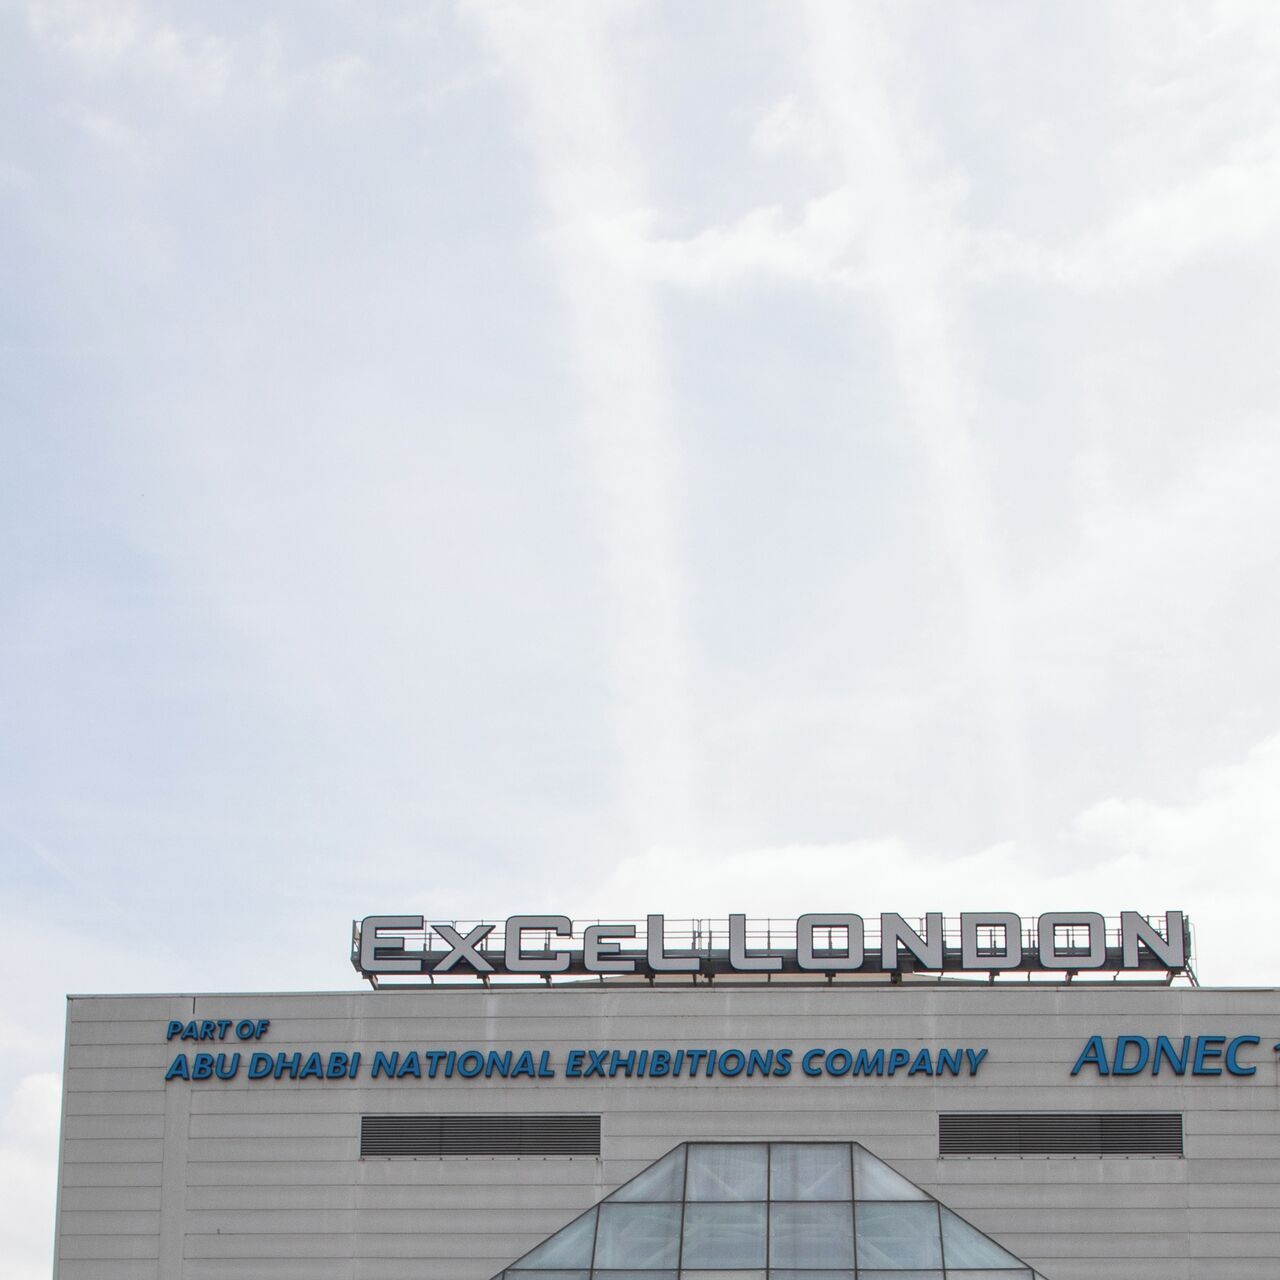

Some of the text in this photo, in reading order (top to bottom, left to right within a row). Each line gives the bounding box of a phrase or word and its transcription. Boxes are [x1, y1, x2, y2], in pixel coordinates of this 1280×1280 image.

[728, 911, 1185, 971] LONDON
[166, 1019, 269, 1041] PART OF
[165, 1048, 987, 1080] ABU DHABI NATIONAL EXHIBITIONS COMPANY
[1072, 1035, 1260, 1076] ADNEC
